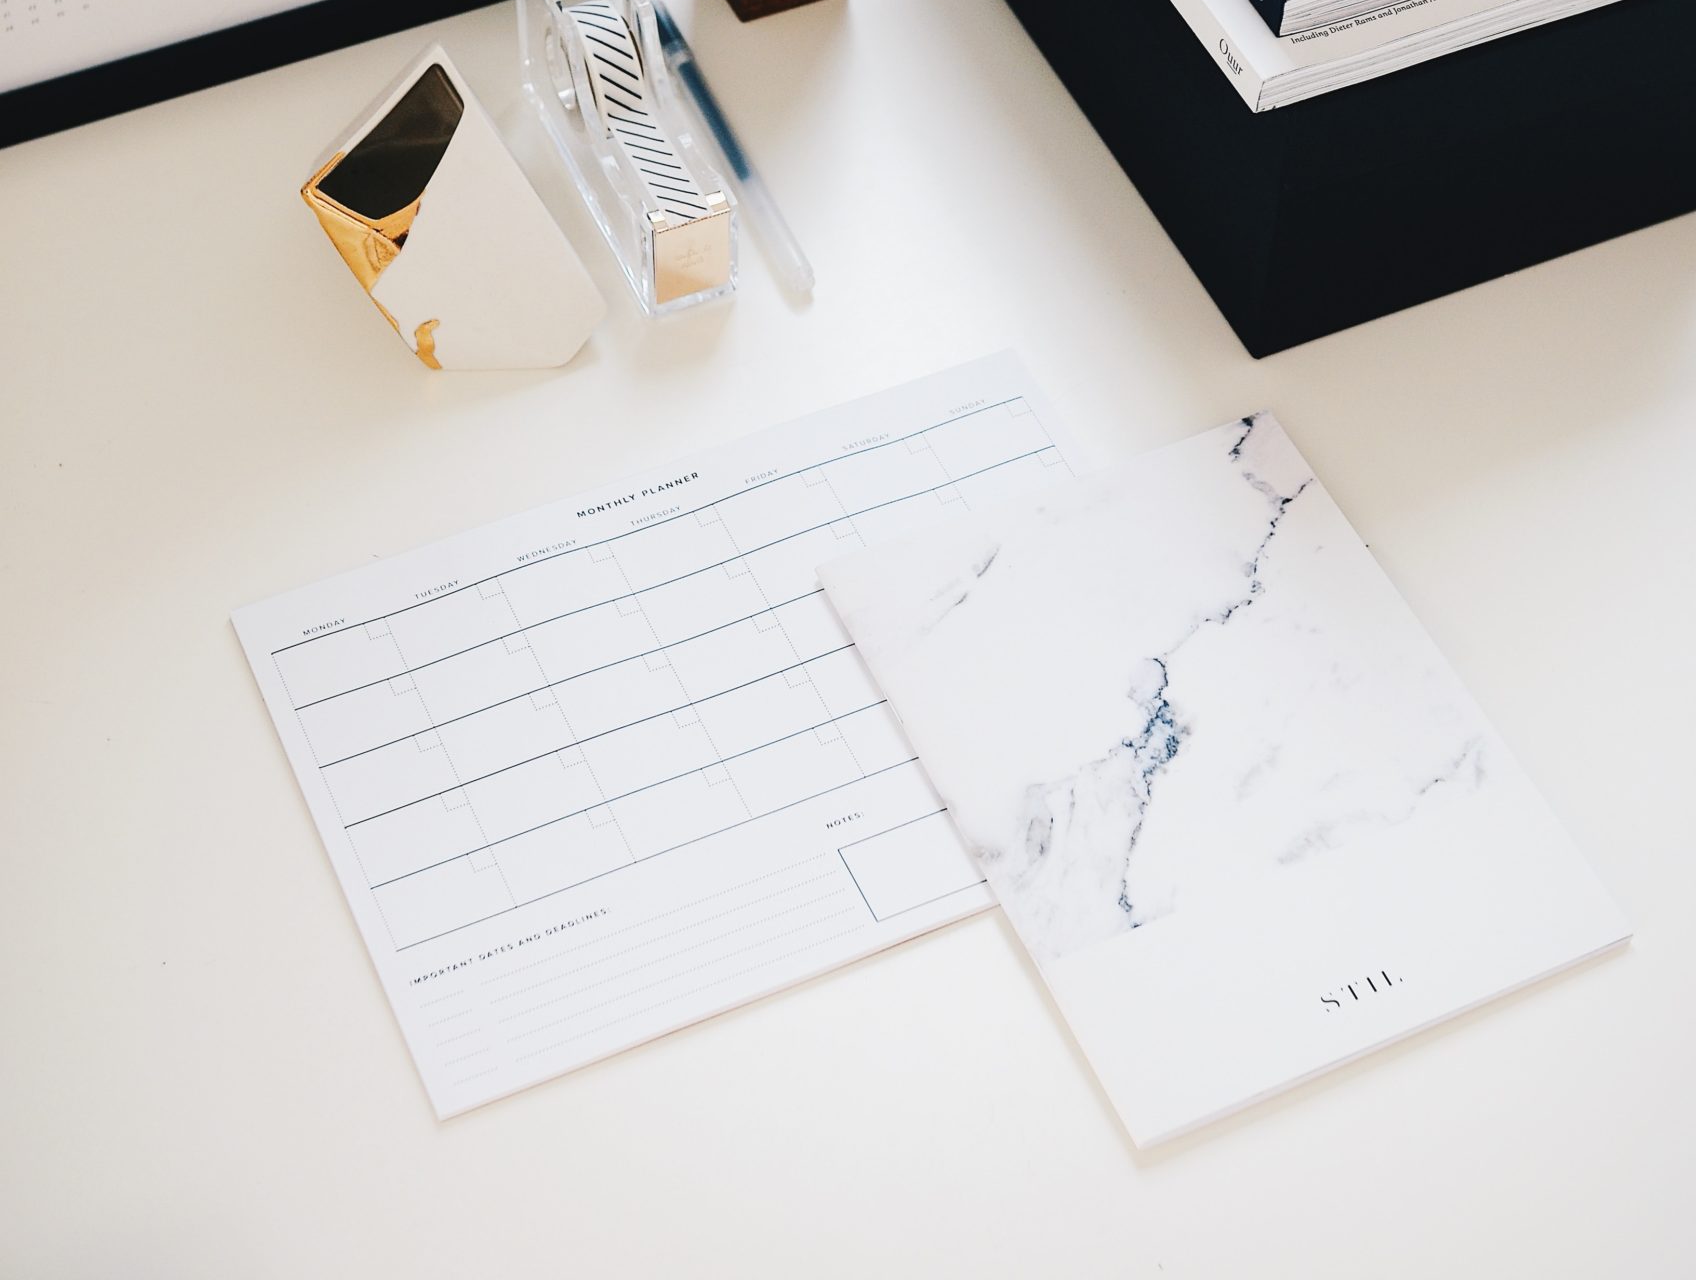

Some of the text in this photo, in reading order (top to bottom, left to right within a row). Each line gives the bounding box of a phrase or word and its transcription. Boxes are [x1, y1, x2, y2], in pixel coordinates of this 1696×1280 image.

[1290, 28, 1330, 45] Including
[1329, 20, 1354, 35] Dieter
[1354, 14, 1377, 27] Rams
[1377, 7, 1393, 20] and
[1218, 37, 1244, 76] Ouur
[576, 471, 700, 518] MONTHLY PLANNER
[301, 397, 987, 637] MONDAY TUESDAY WEDNESDAY THURSDAY FRIDAY SATURDAY SUNDAY
[826, 811, 865, 830] NOTES:
[409, 958, 474, 987] IMPORTANT
[478, 943, 514, 961] DATES
[518, 932, 541, 948] AND
